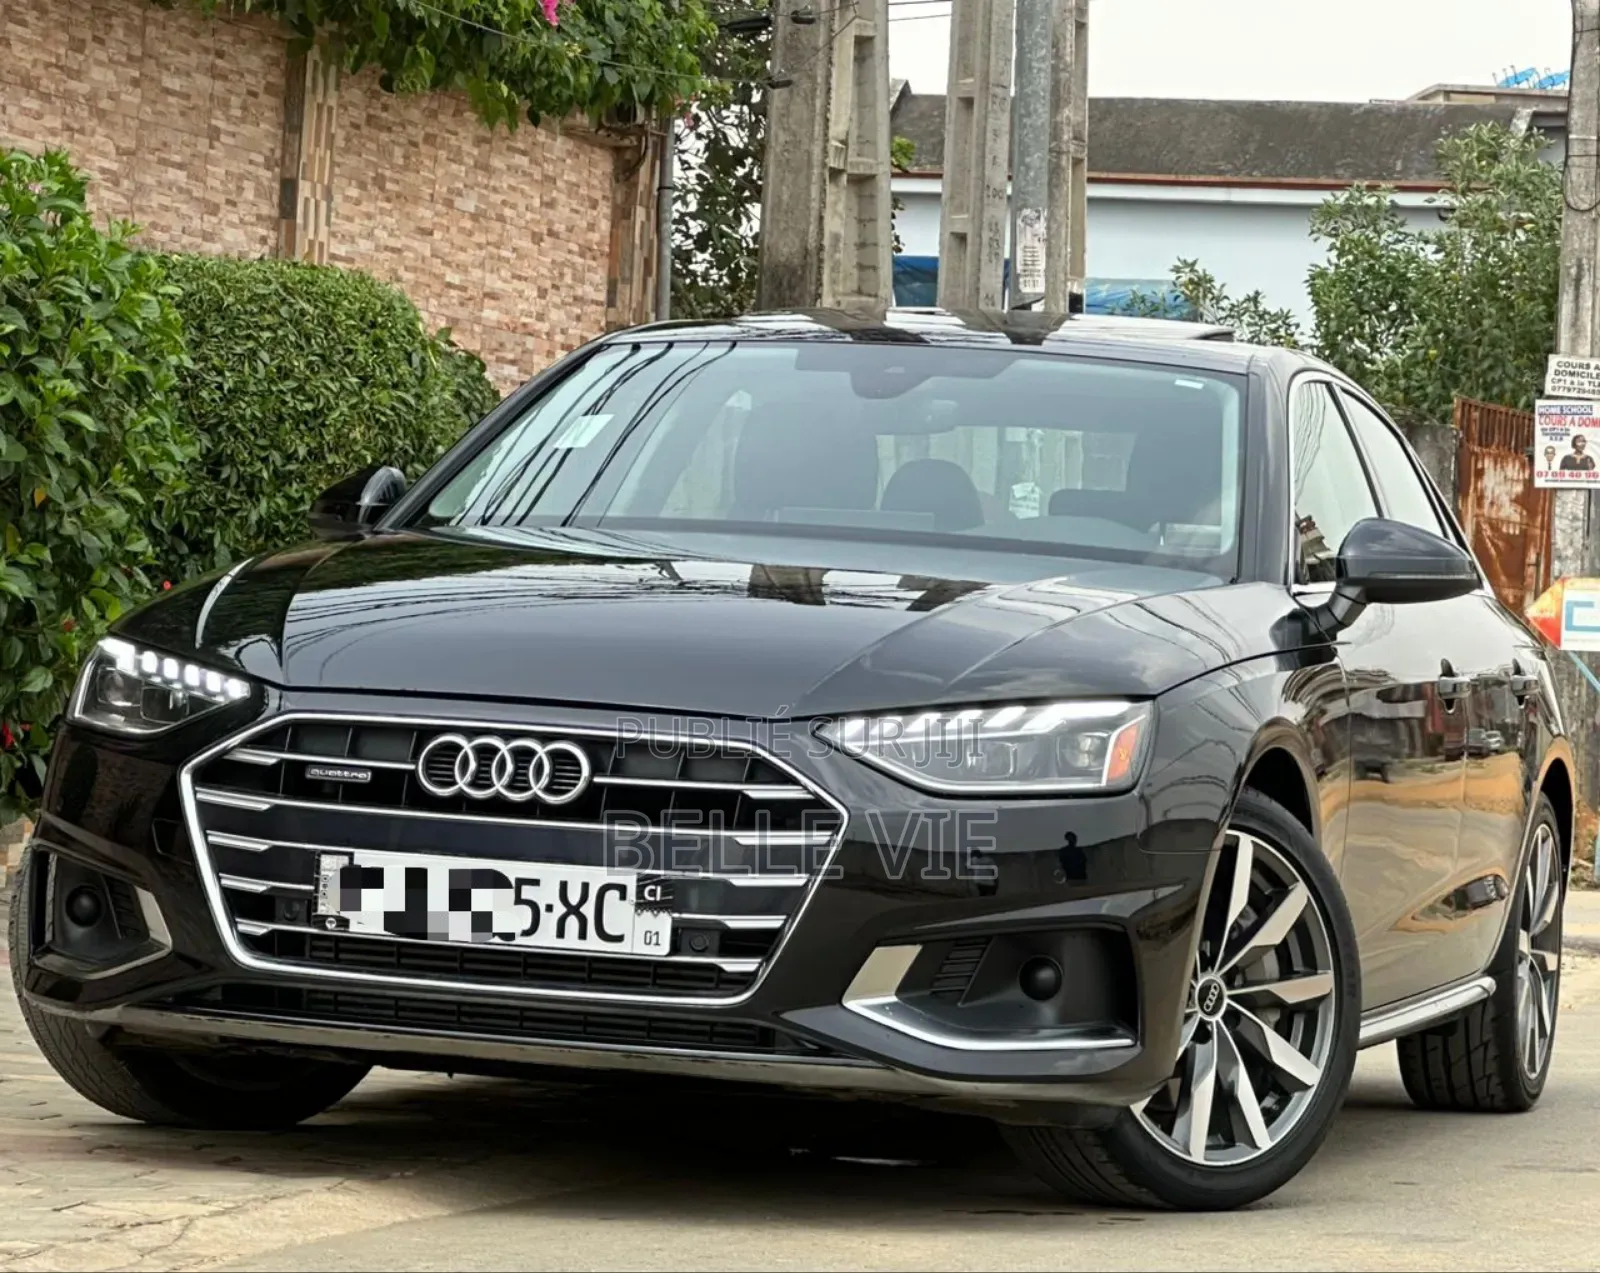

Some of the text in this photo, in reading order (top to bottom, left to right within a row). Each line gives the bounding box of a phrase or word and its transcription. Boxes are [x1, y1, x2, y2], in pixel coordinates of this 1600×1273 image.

[1556, 360, 1591, 370] COURS
[1554, 368, 1600, 379] DOMICILE
[1562, 405, 1593, 415] SCHOOL
[1538, 415, 1567, 426] COURS
[1569, 416, 1576, 427] A
[310, 768, 367, 780] quattro
[644, 885, 661, 901] CI
[644, 930, 661, 946] 01
